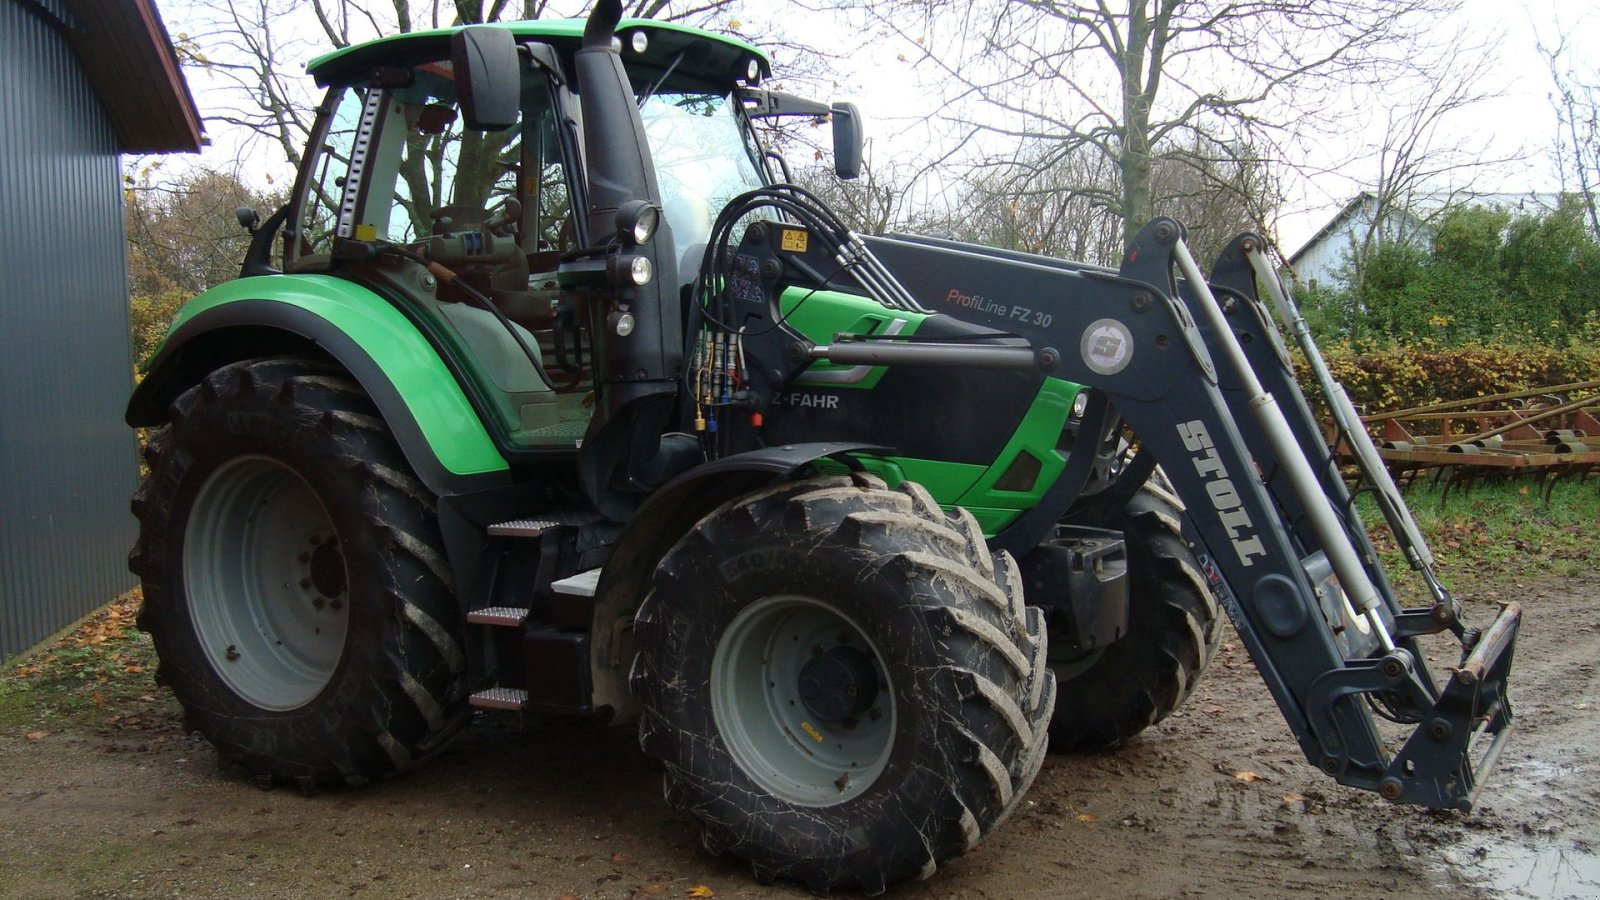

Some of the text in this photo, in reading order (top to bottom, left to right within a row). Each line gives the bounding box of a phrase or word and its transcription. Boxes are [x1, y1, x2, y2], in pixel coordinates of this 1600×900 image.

[946, 289, 1053, 328] ProfiLine FZ 30
[1175, 419, 1267, 567] STOLL
